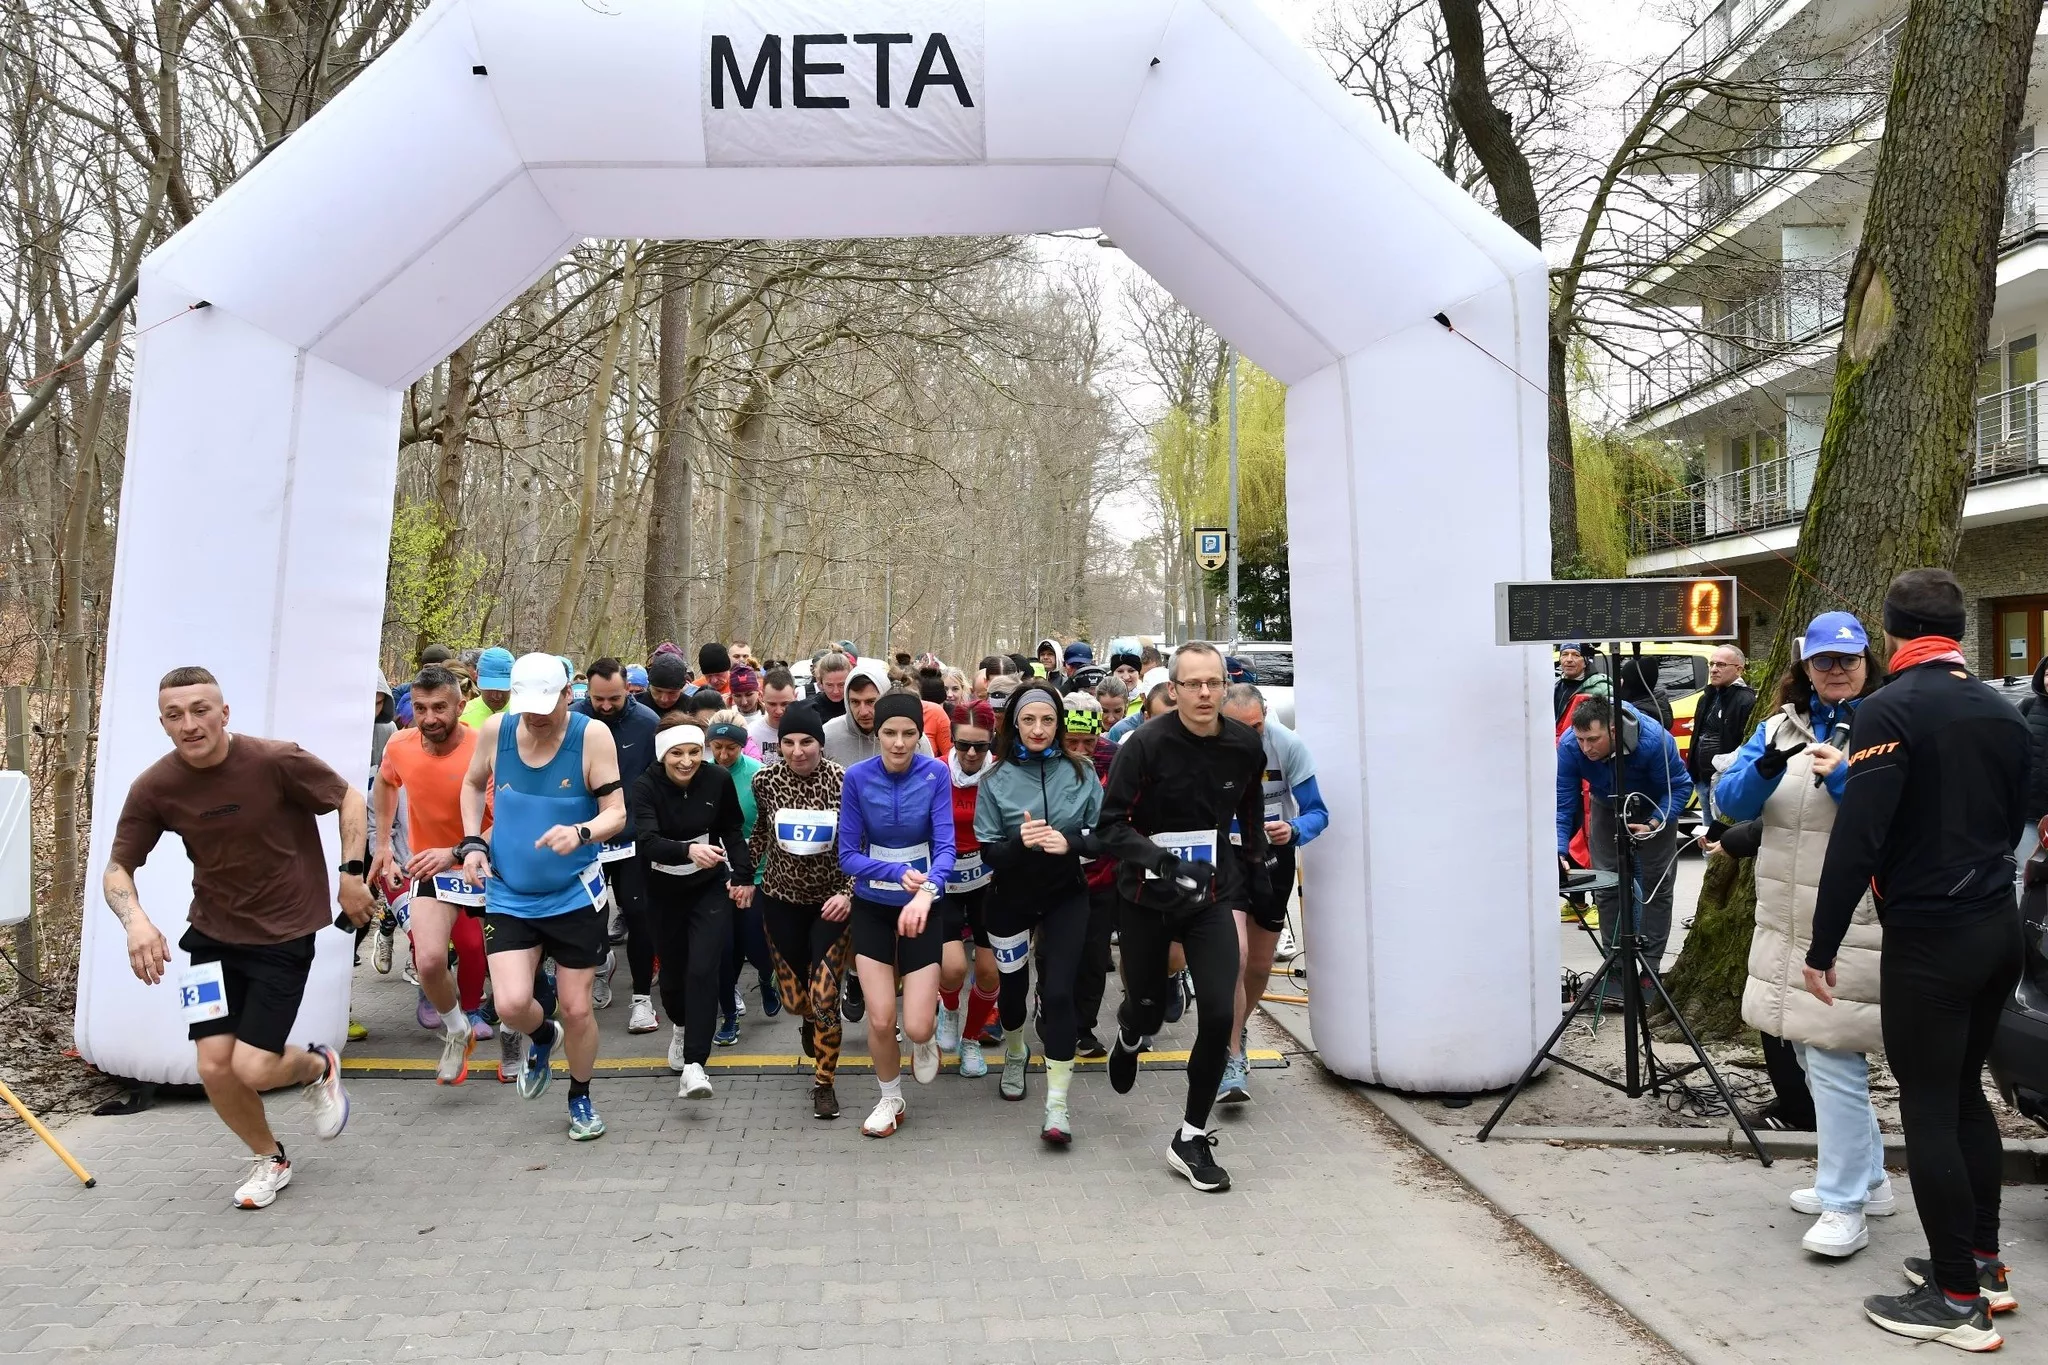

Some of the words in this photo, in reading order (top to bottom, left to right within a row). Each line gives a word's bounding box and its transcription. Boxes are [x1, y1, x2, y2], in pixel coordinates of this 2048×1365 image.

[710, 32, 974, 109] META
[1690, 582, 1720, 634] 0
[793, 825, 817, 842] 67
[961, 867, 982, 882] 30
[450, 878, 473, 894] 35
[996, 949, 1015, 962] 41
